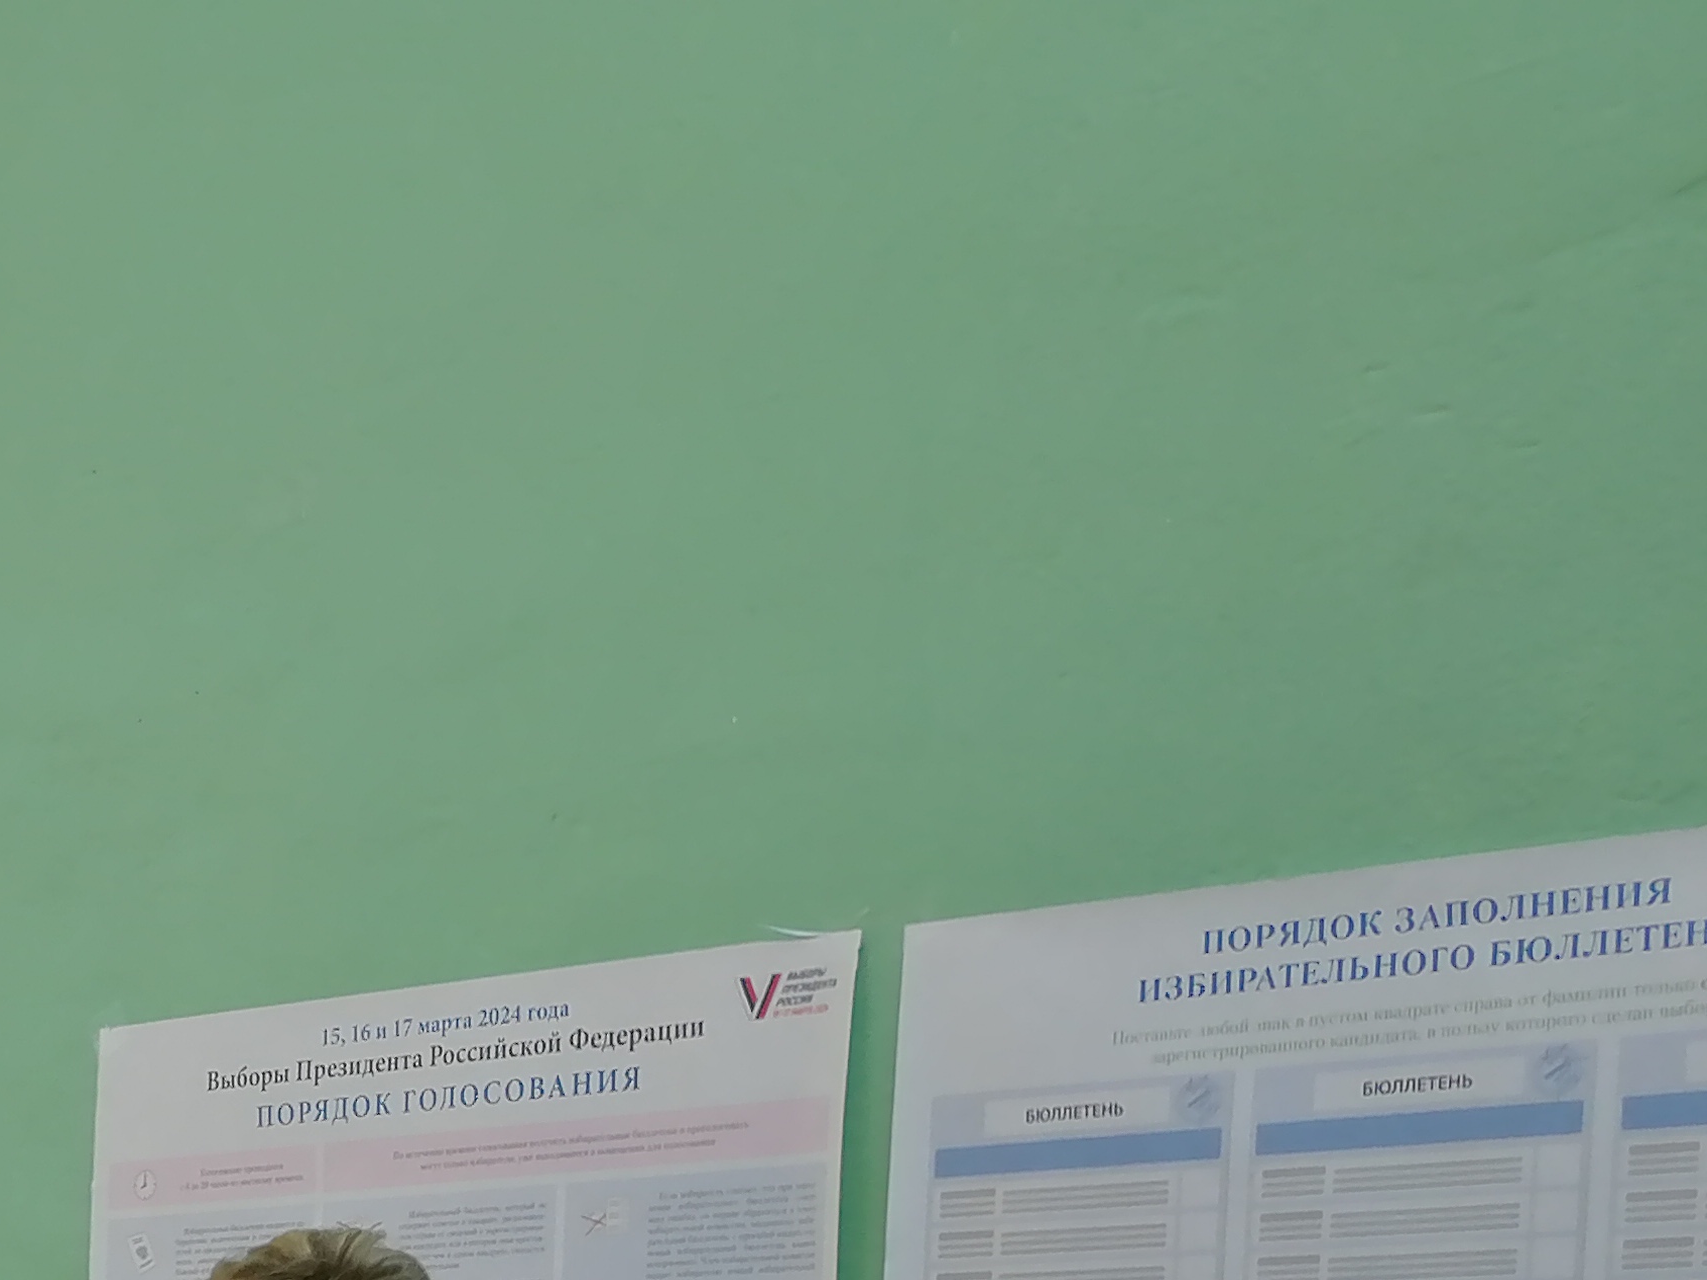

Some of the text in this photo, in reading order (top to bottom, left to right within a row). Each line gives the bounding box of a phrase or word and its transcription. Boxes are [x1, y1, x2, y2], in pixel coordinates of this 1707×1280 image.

[1203, 877, 1673, 955] ПОРЯДОК ЗАПОЛНЕНИЯ
[1138, 945, 1476, 1003] ИЗБИРАТЕЛЬНОГО
[321, 1001, 570, 1047] 15, 16 и 17 марта 2024 года
[207, 1018, 705, 1093] Выборы Президента Российской Федерации
[257, 1066, 641, 1129] ПОРЯДОК ГОЛОСОВАНИЯ
[1025, 1102, 1124, 1124] БЮЛЛЕТЕНЬ
[1362, 1073, 1473, 1097] БЮЛЛЕТЕНЬ
